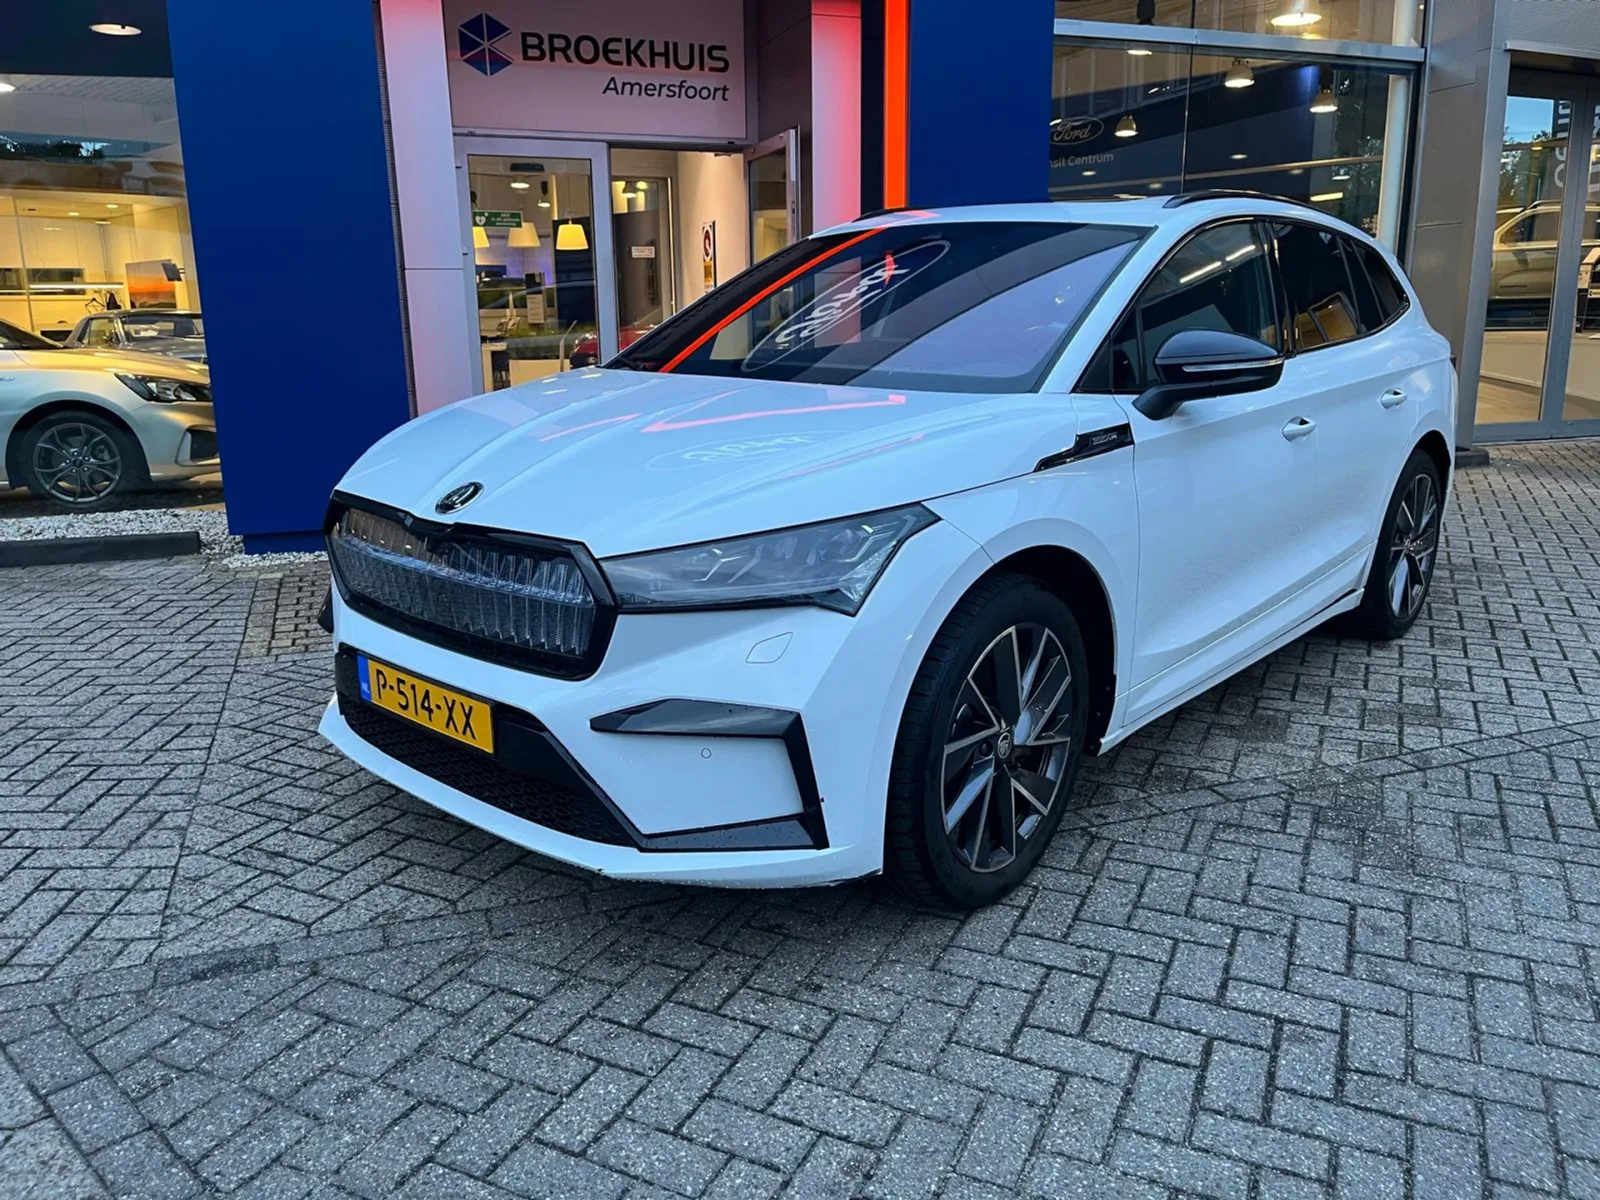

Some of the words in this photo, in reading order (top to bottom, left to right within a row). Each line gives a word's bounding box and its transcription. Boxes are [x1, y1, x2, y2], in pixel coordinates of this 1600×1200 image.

[520, 31, 730, 73] BROEKHUIS
[602, 77, 729, 102] Amersfoort
[1053, 121, 1092, 142] Ford
[1067, 153, 1114, 167] Centrum
[375, 668, 477, 740] P-514-XX
